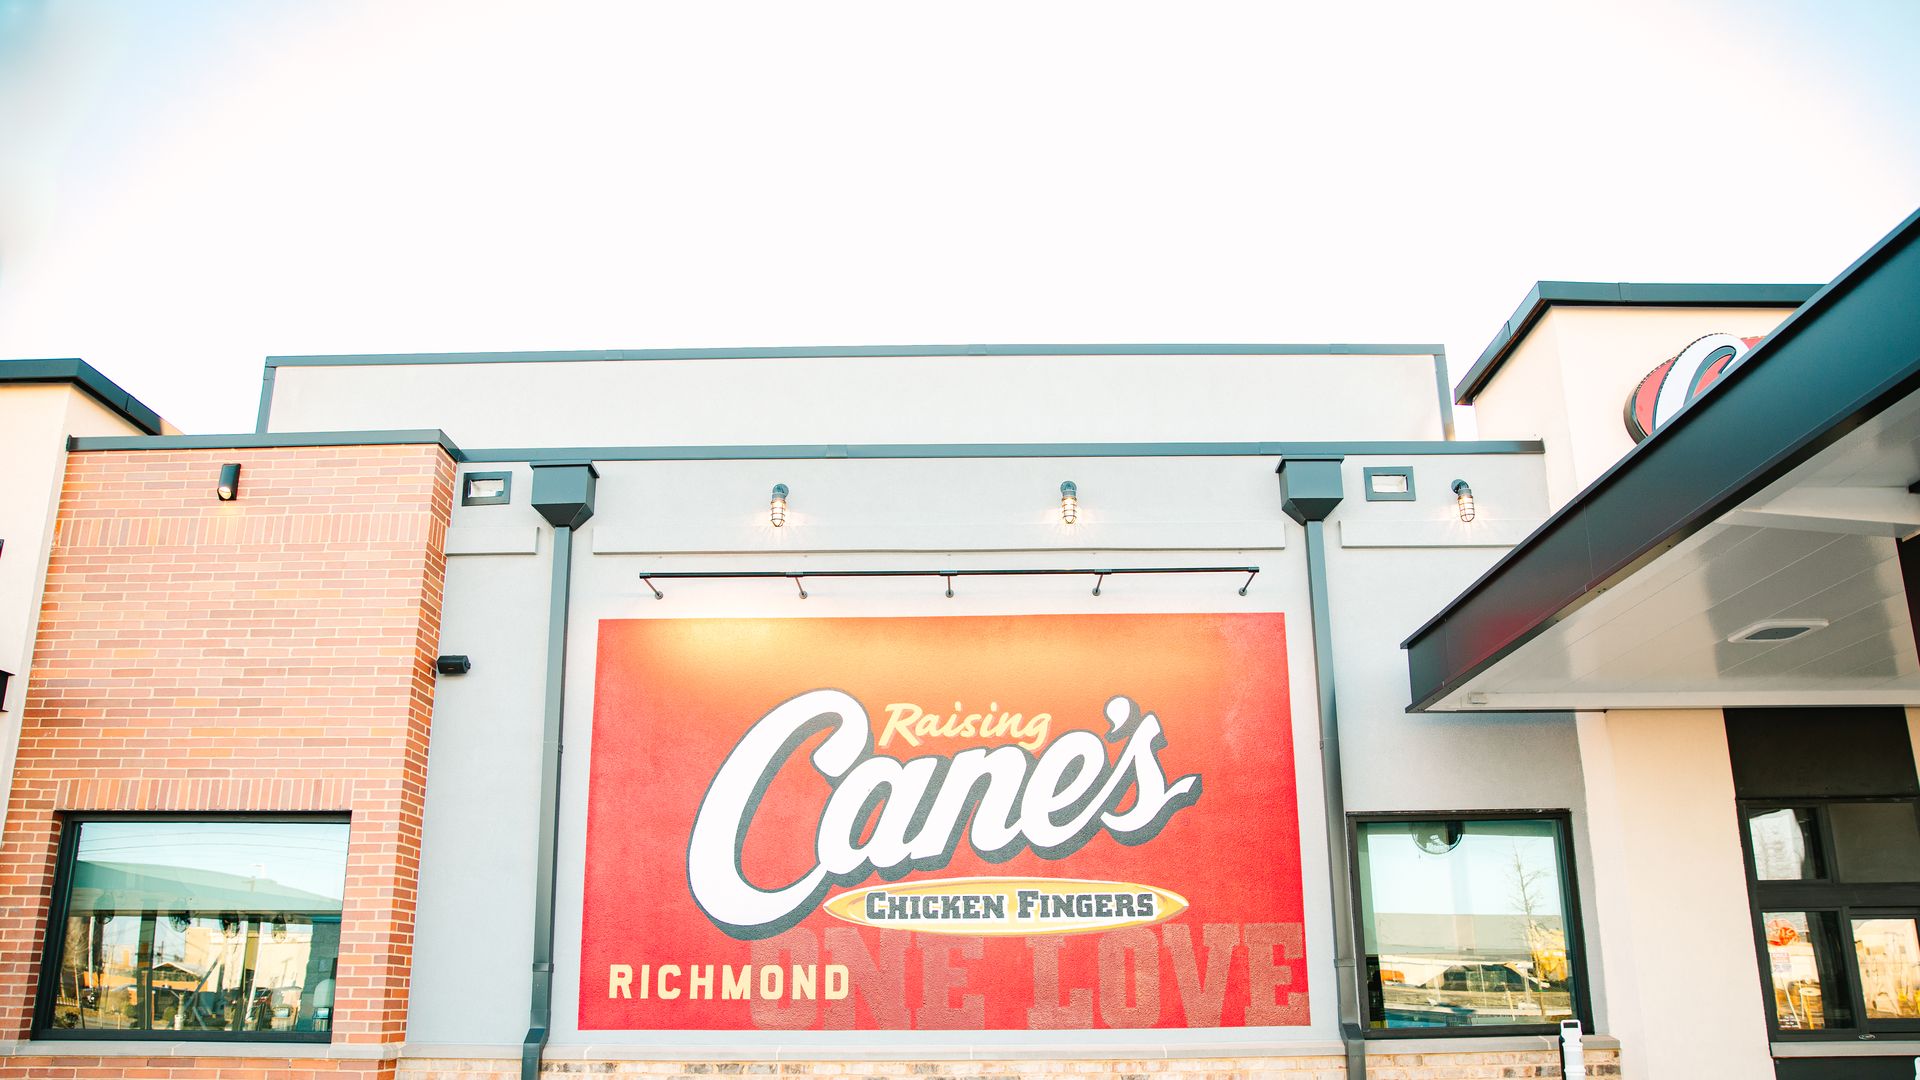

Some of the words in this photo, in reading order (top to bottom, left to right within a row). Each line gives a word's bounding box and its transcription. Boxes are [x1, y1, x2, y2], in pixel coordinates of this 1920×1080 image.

[878, 701, 1052, 751] Raising
[686, 688, 1203, 940] Cane's
[865, 892, 1004, 920] CHICKEN
[1017, 890, 1153, 918] FINGERS
[608, 964, 850, 1000] RICHMOND
[750, 926, 985, 1030] ONE
[1026, 923, 1310, 1030] LOVE
